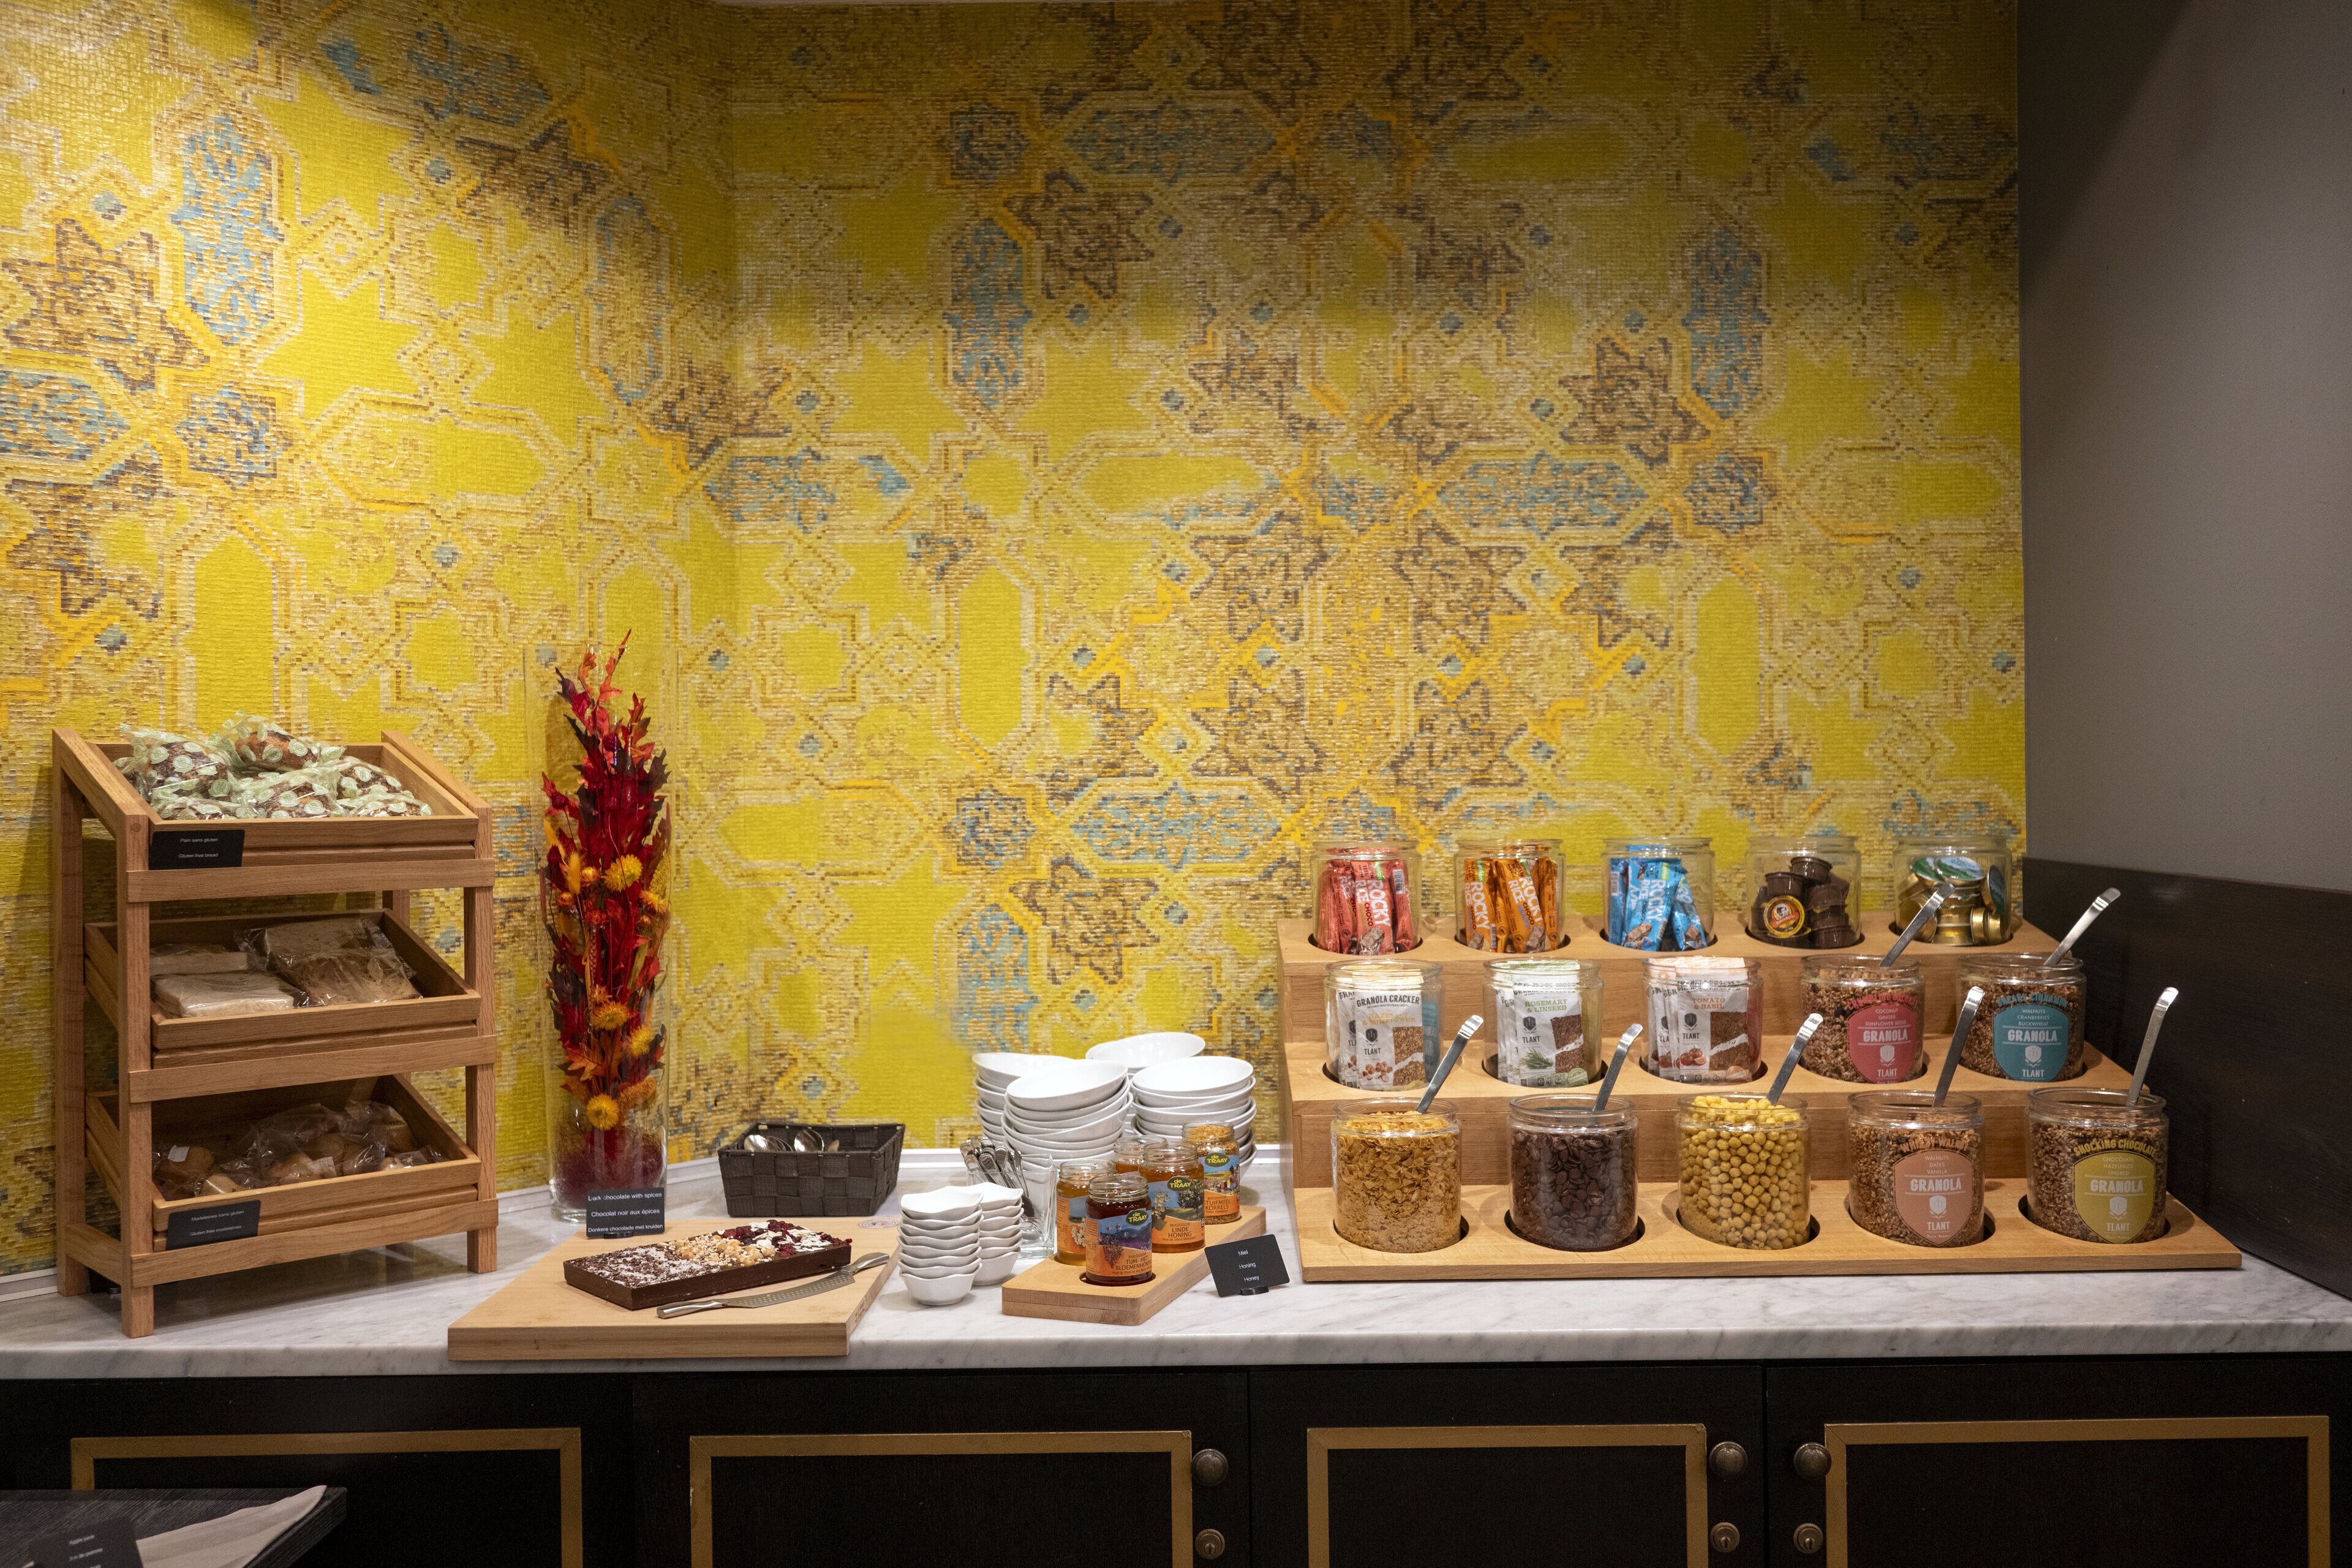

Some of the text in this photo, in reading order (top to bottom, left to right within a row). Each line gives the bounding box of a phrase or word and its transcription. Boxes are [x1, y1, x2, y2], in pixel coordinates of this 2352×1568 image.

[1355, 880, 1370, 903] RICE
[1464, 882, 1473, 906] RICE
[1509, 879, 1526, 904] RICE
[1638, 880, 1651, 900] RICE
[1367, 880, 1391, 927] ROCKY
[1471, 882, 1491, 929] ROCKY
[1646, 880, 1667, 921] ROCKY
[1364, 902, 1374, 927] CHOCO
[1523, 902, 1535, 925] CHOCO
[1357, 995, 1420, 1008] GRANOLA CRACKER
[1525, 999, 1567, 1008] ROSEMARY
[1863, 1028, 1908, 1042] GRANOLA
[2008, 1030, 2057, 1042] GRANOLA
[1877, 1068, 1898, 1077] TLANT
[2022, 1069, 2045, 1077] TLANT
[2073, 1138, 2157, 1157] SHOCKING CHOCOLATE
[1910, 1177, 1962, 1192] GRANOLA
[2090, 1179, 2144, 1193] GRANOLA
[1128, 1214, 1148, 1223] TRAAY
[1926, 1221, 1950, 1231] TLANT
[2106, 1223, 2130, 1231] TLANT
